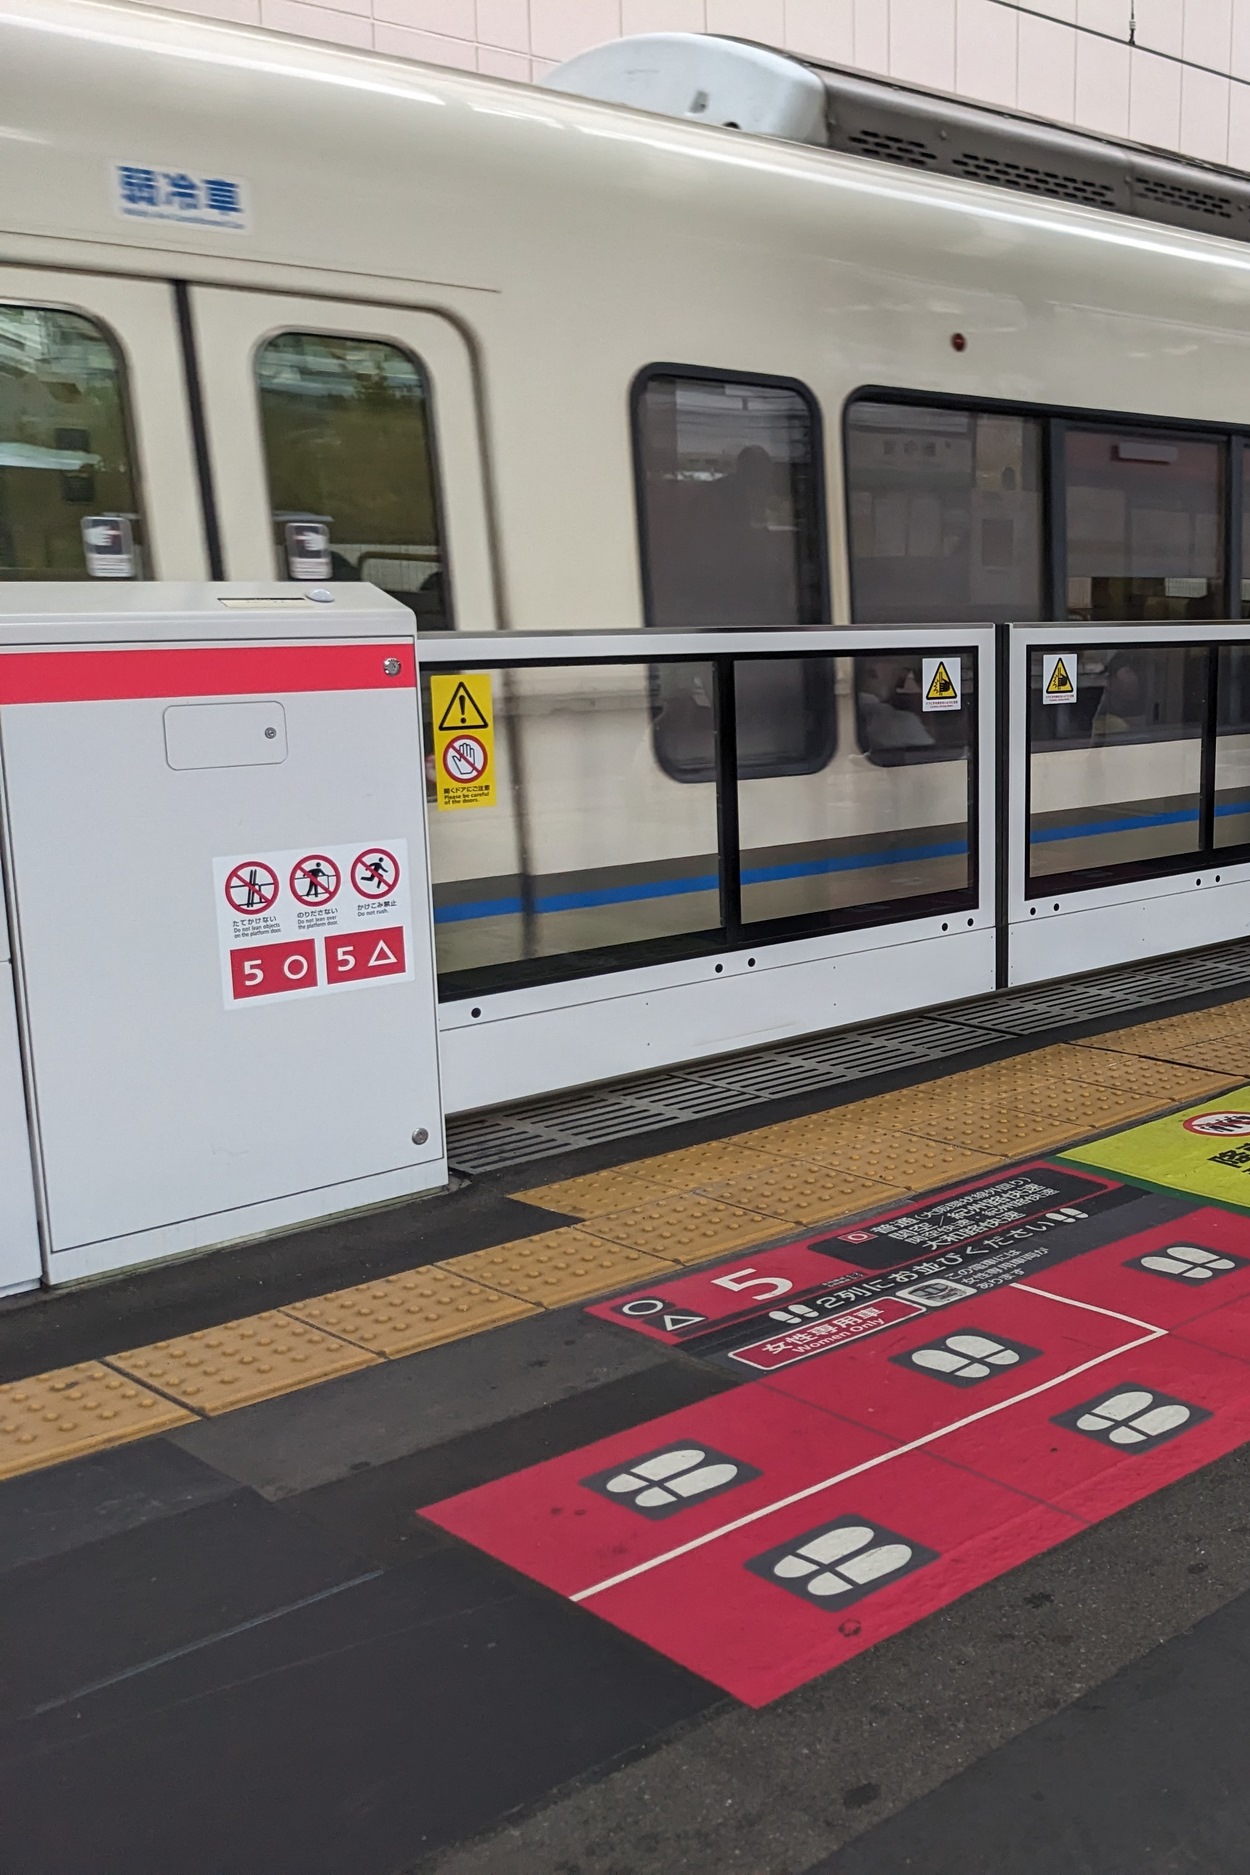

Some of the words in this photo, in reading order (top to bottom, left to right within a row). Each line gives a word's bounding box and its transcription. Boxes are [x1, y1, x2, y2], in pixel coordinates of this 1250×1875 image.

[297, 908, 338, 919] のりださない
[357, 900, 397, 911] かけこみ禁止
[232, 916, 277, 928] たてかけない
[250, 929, 269, 938] platform
[263, 922, 280, 931] objects
[306, 921, 326, 930] platform
[337, 946, 356, 972] 5
[244, 959, 264, 986] 5
[922, 1211, 1026, 1251] 大和路快速
[816, 1220, 1055, 1309] 2列にお並びください
[711, 1268, 793, 1301] 5
[976, 1268, 1025, 1290] あります
[762, 1306, 884, 1356] 女性専用車
[791, 1331, 850, 1355] Women
[849, 1317, 885, 1336] Only
